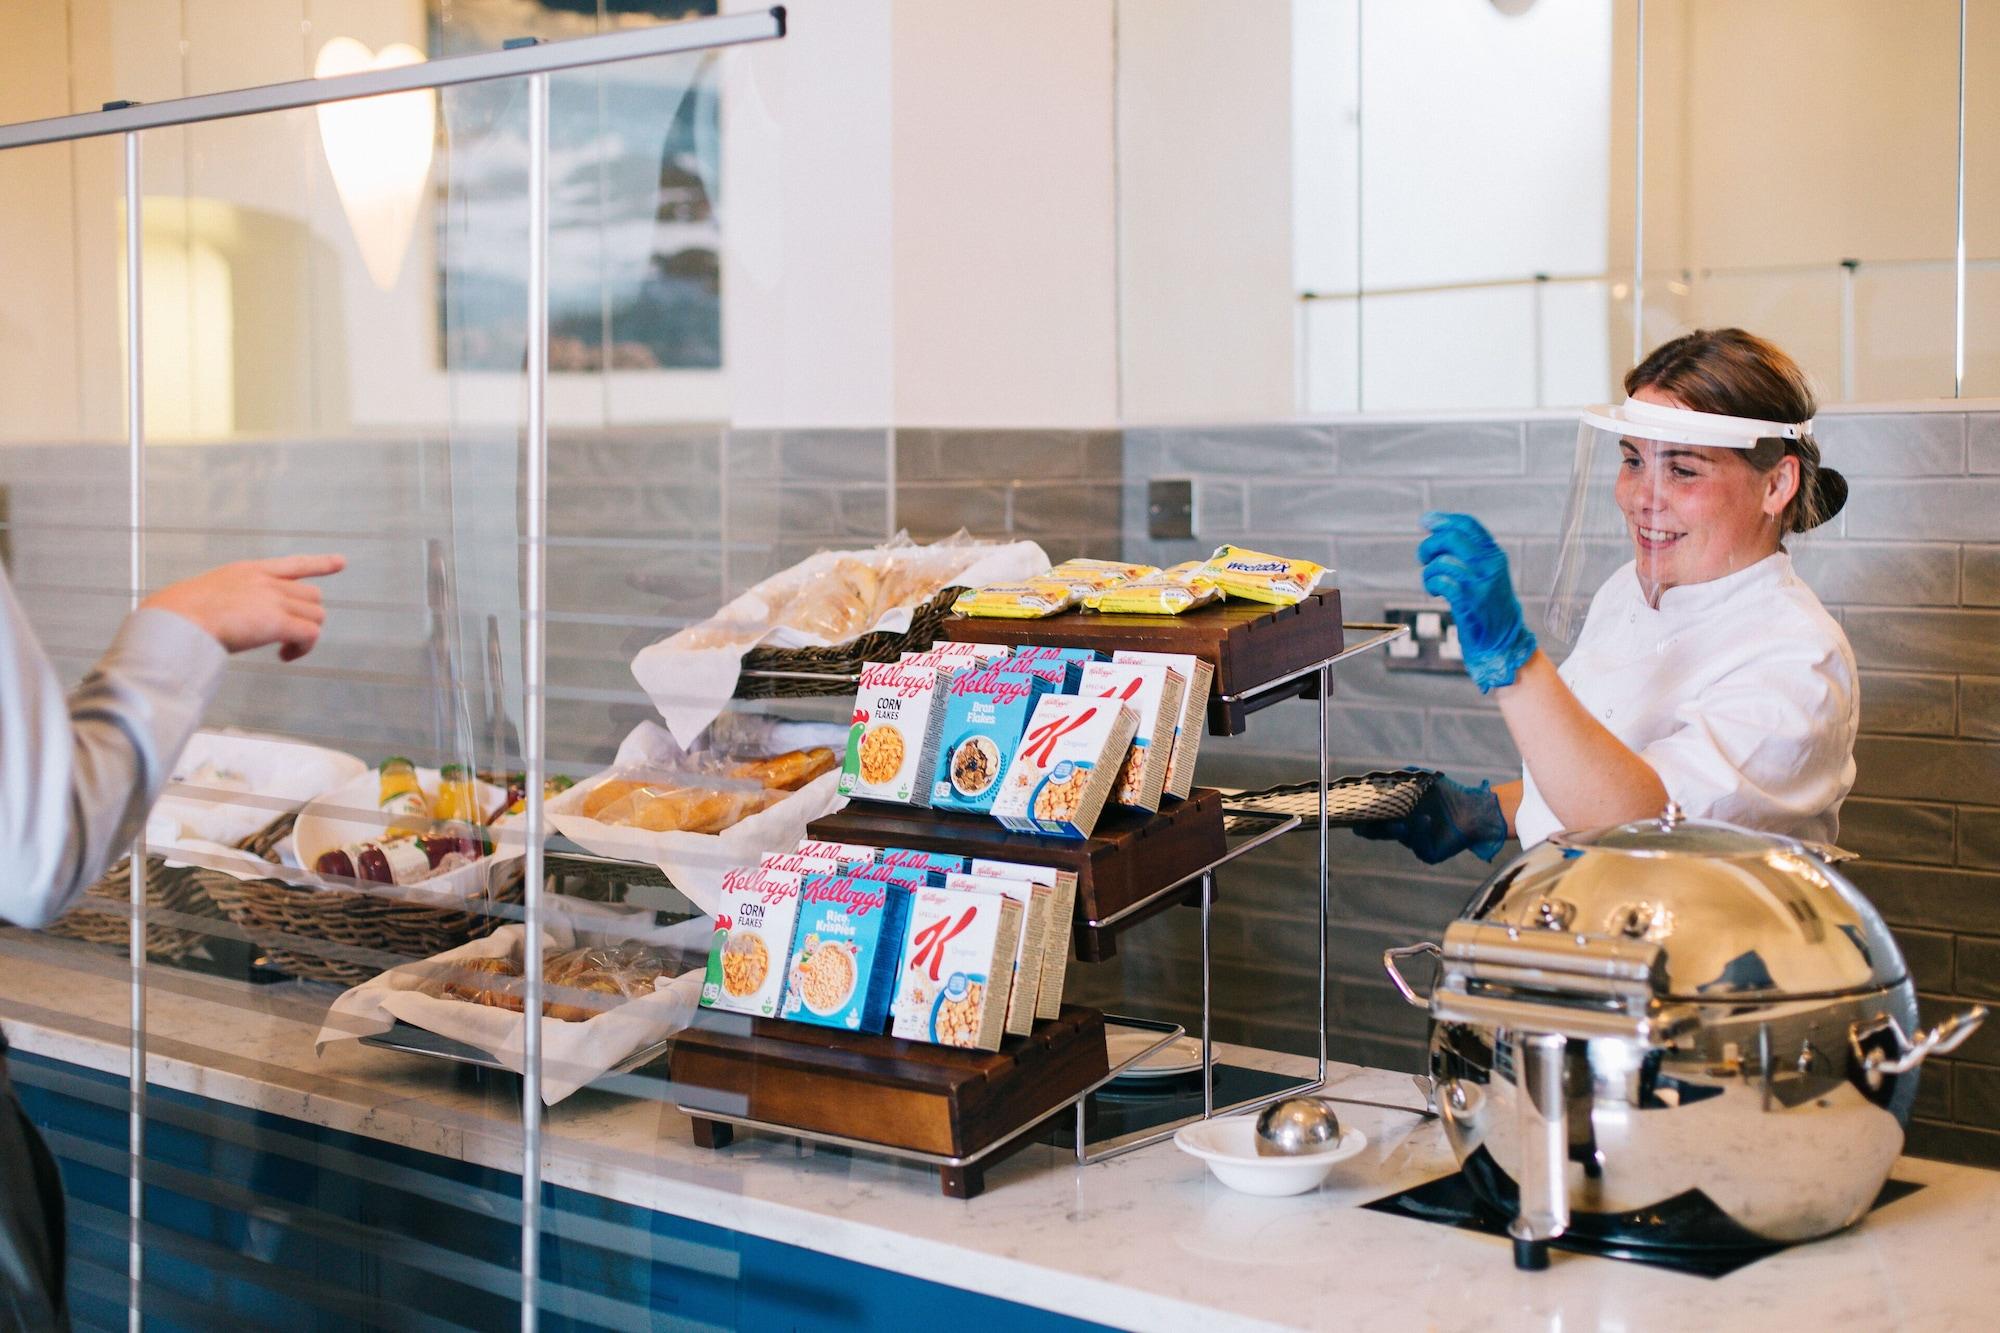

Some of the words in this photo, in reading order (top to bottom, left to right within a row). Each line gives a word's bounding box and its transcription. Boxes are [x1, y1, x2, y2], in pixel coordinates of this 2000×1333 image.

[858, 664, 935, 698] Kellogg's
[950, 669, 1032, 705] Kellogg's
[875, 710, 900, 720] FLAKES
[877, 698, 901, 711] CORN
[1019, 707, 1098, 769] K
[721, 867, 799, 906] Kellogg's
[803, 874, 886, 917] Kellogg's
[737, 917, 763, 929] FLAKES
[740, 903, 766, 918] CORN
[910, 906, 977, 981] K
